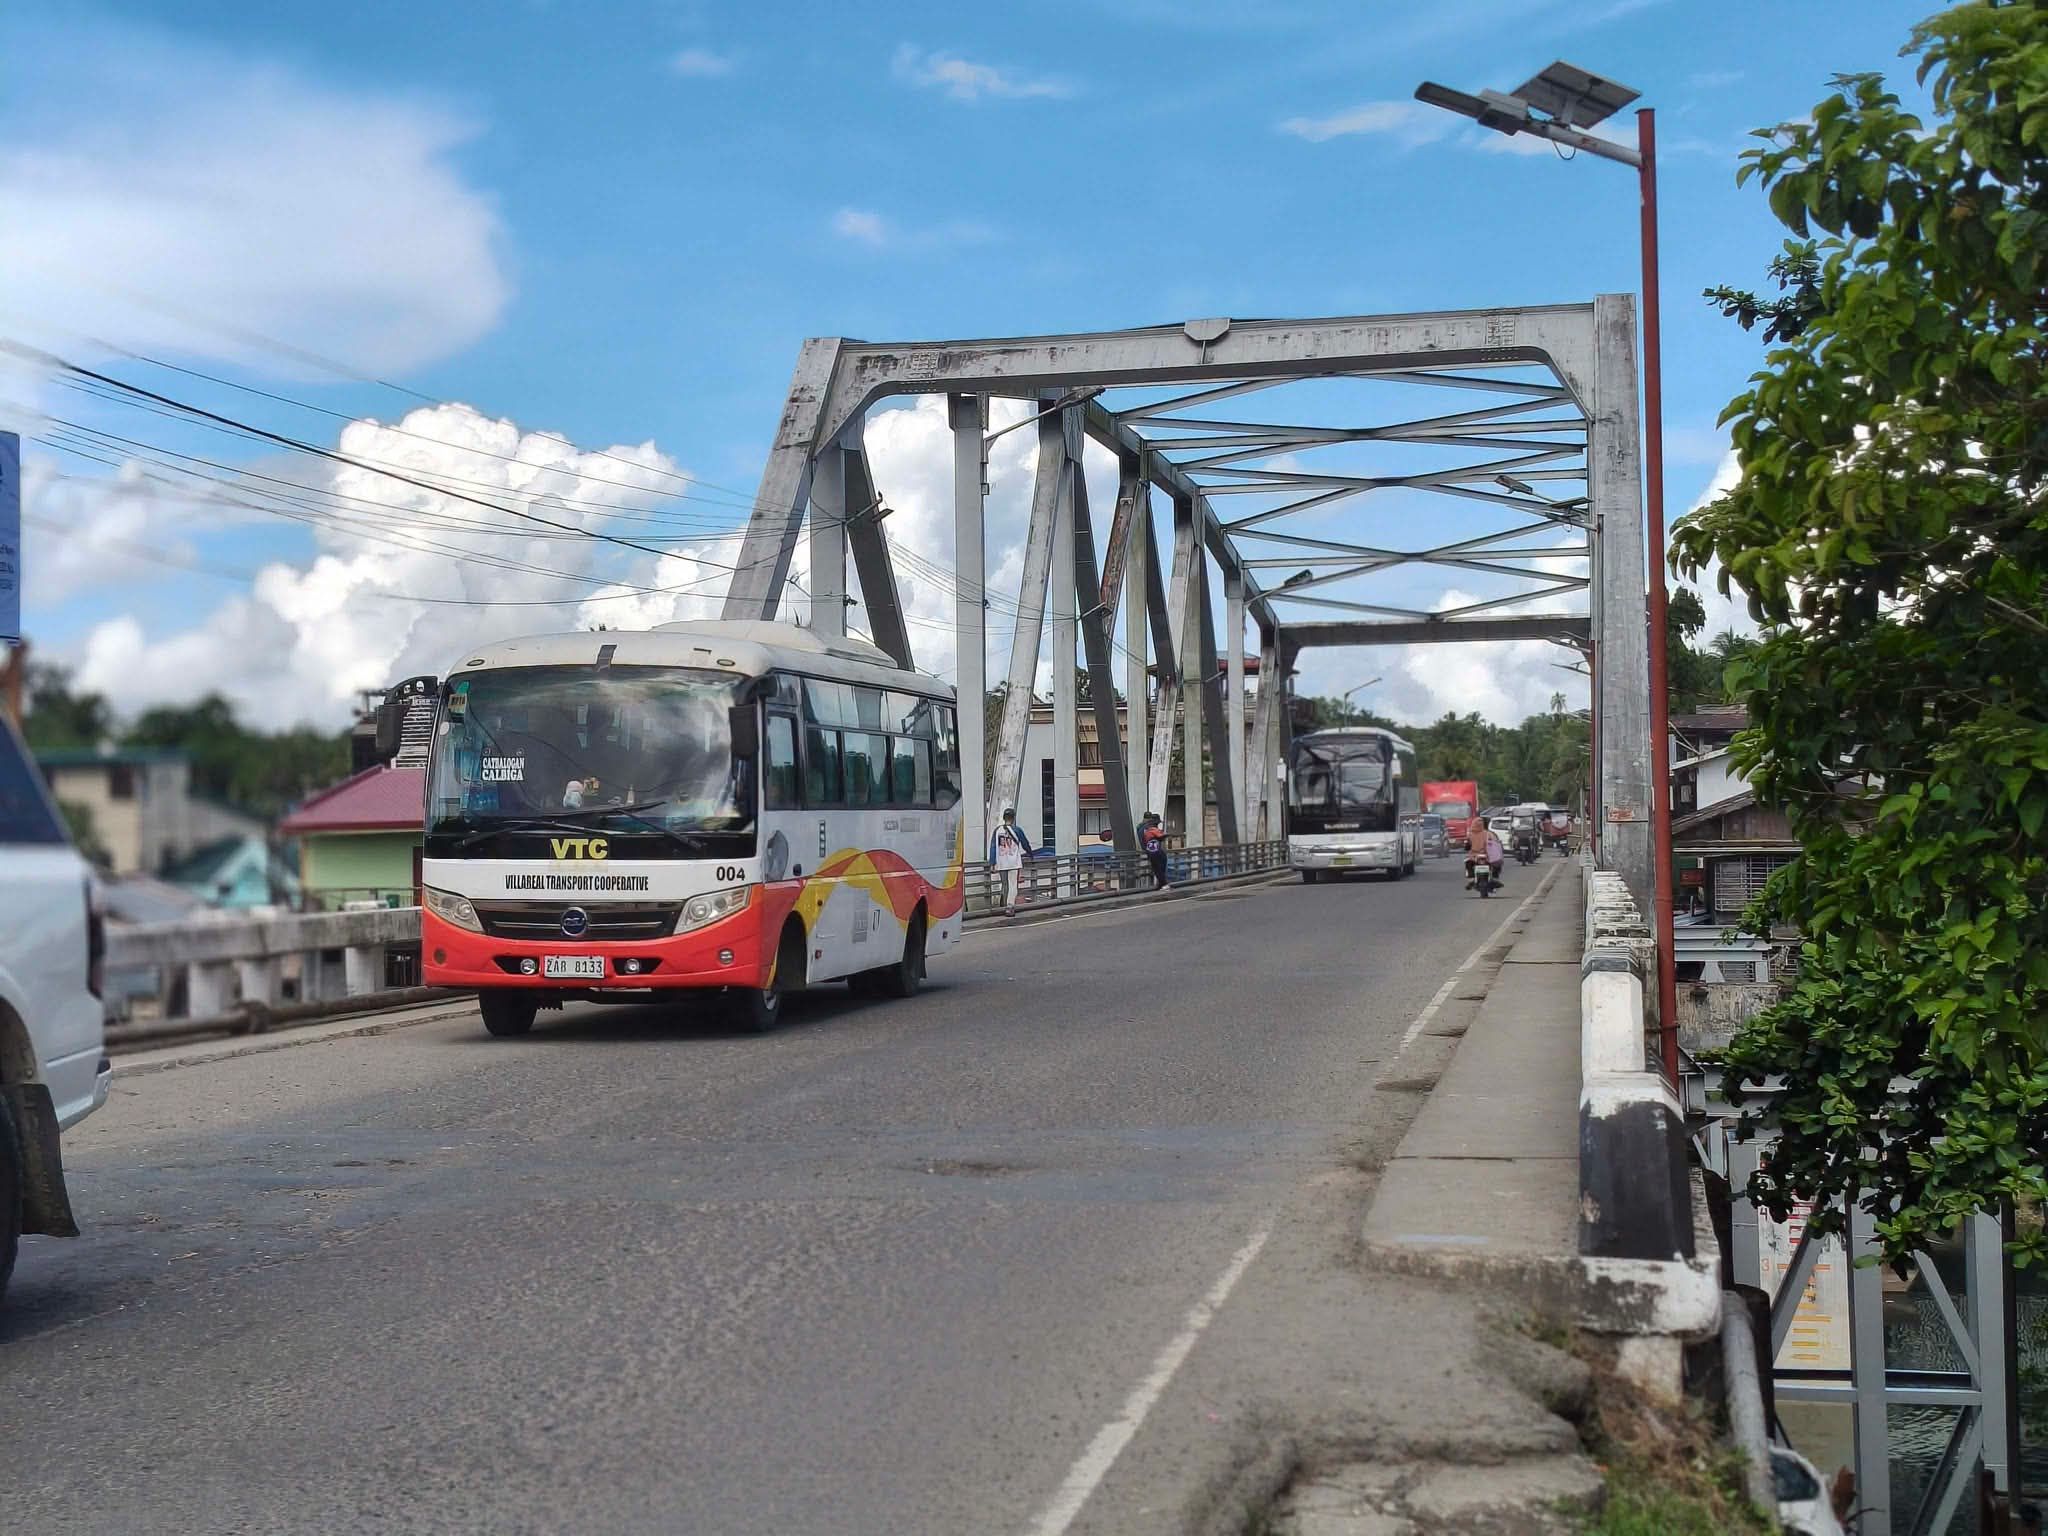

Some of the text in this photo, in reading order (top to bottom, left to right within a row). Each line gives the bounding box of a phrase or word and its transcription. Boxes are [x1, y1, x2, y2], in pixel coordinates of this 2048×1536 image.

[482, 769, 524, 781] CALBIGA
[551, 838, 608, 859] VTC
[716, 866, 746, 881] 004
[505, 874, 649, 891] VILLAREAL TRANSPORT COOPERATIVE
[574, 960, 603, 974] 8133
